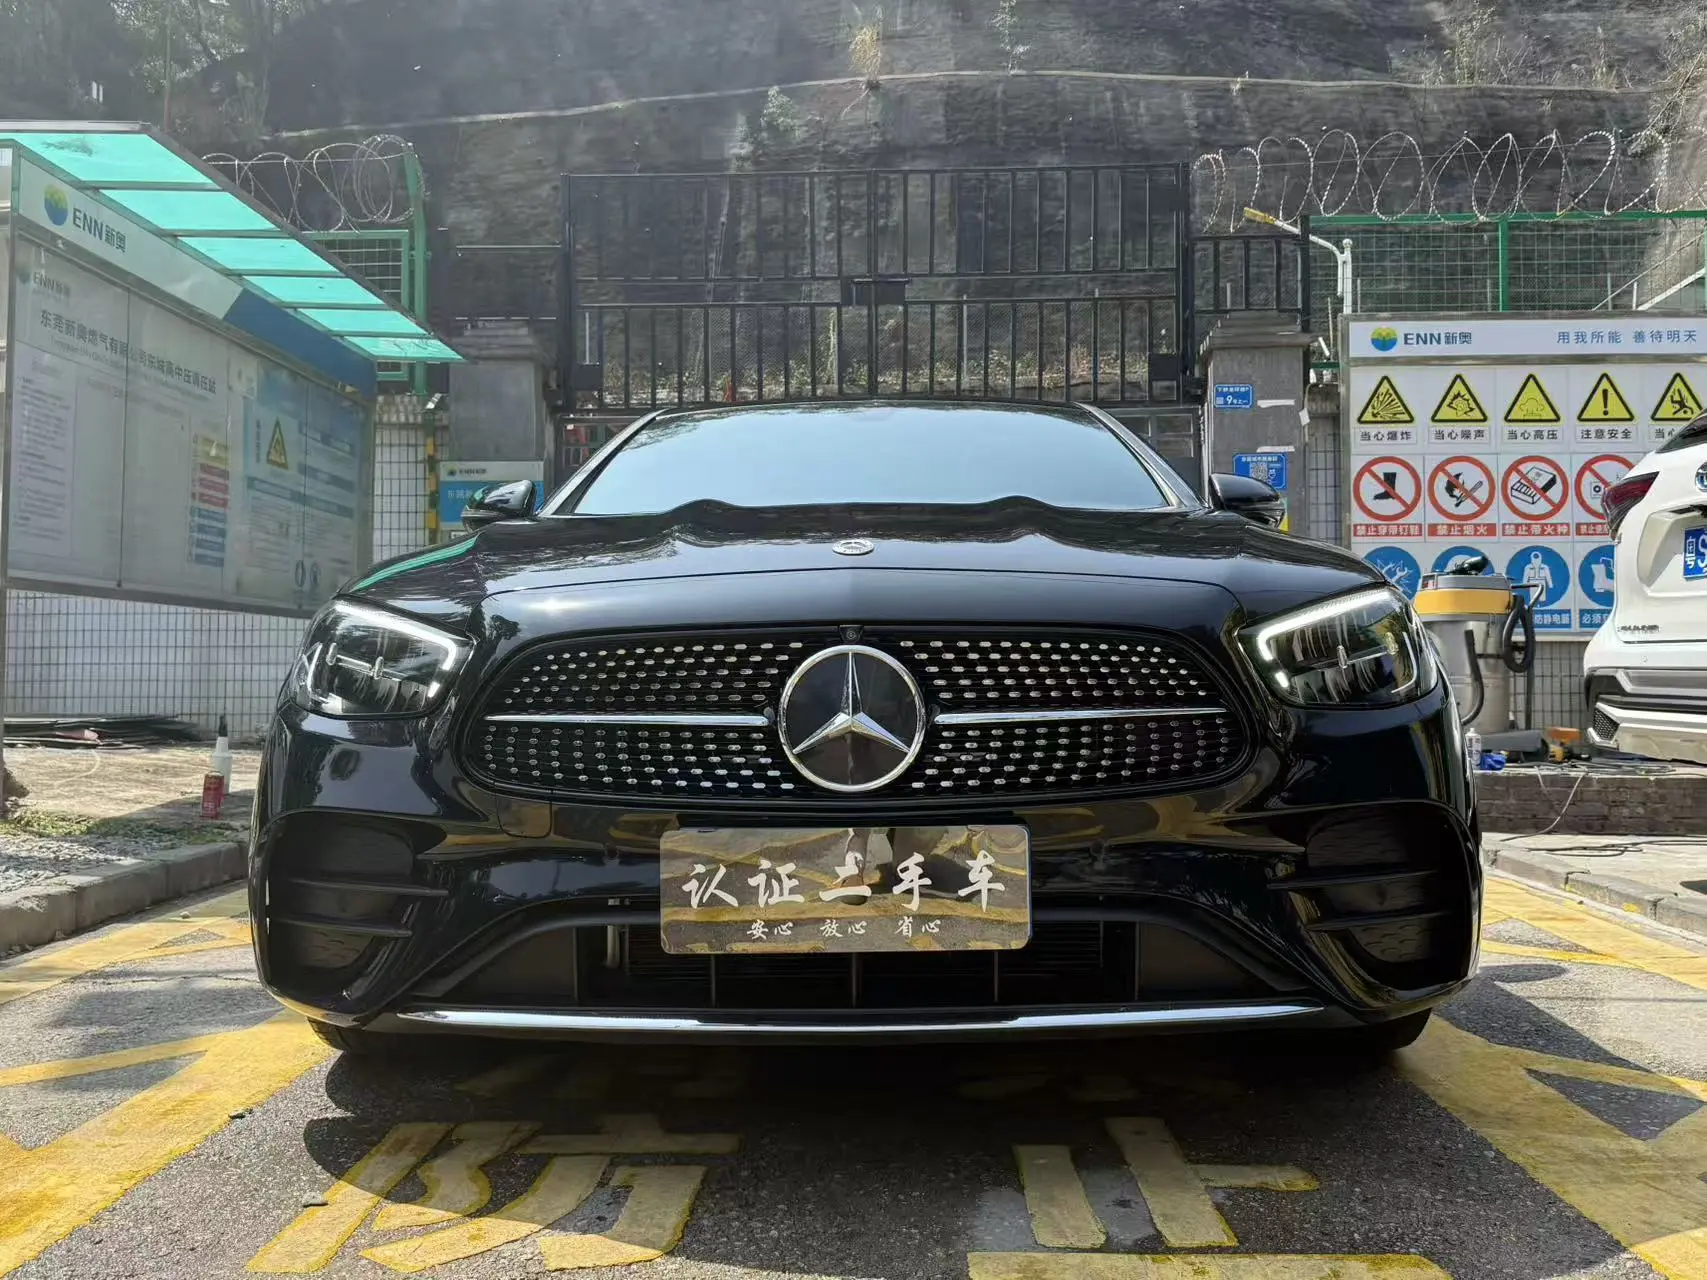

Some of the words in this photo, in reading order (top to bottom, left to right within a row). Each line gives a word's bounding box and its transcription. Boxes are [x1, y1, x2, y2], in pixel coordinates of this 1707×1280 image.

[1403, 331, 1473, 346] ENN新奥
[1556, 330, 1622, 345] 用我所能
[1632, 329, 1698, 344] 善待明天
[1359, 430, 1412, 442] 当心爆炸
[1434, 429, 1485, 441] 当心噪声
[1506, 429, 1559, 441] 当心高压
[1580, 428, 1633, 440] 注意安全
[1436, 524, 1488, 536] 禁止烟火
[681, 849, 1006, 913] 认证二手车
[746, 918, 793, 940] 安心
[820, 918, 867, 938] 放心
[894, 915, 942, 936] 省心
